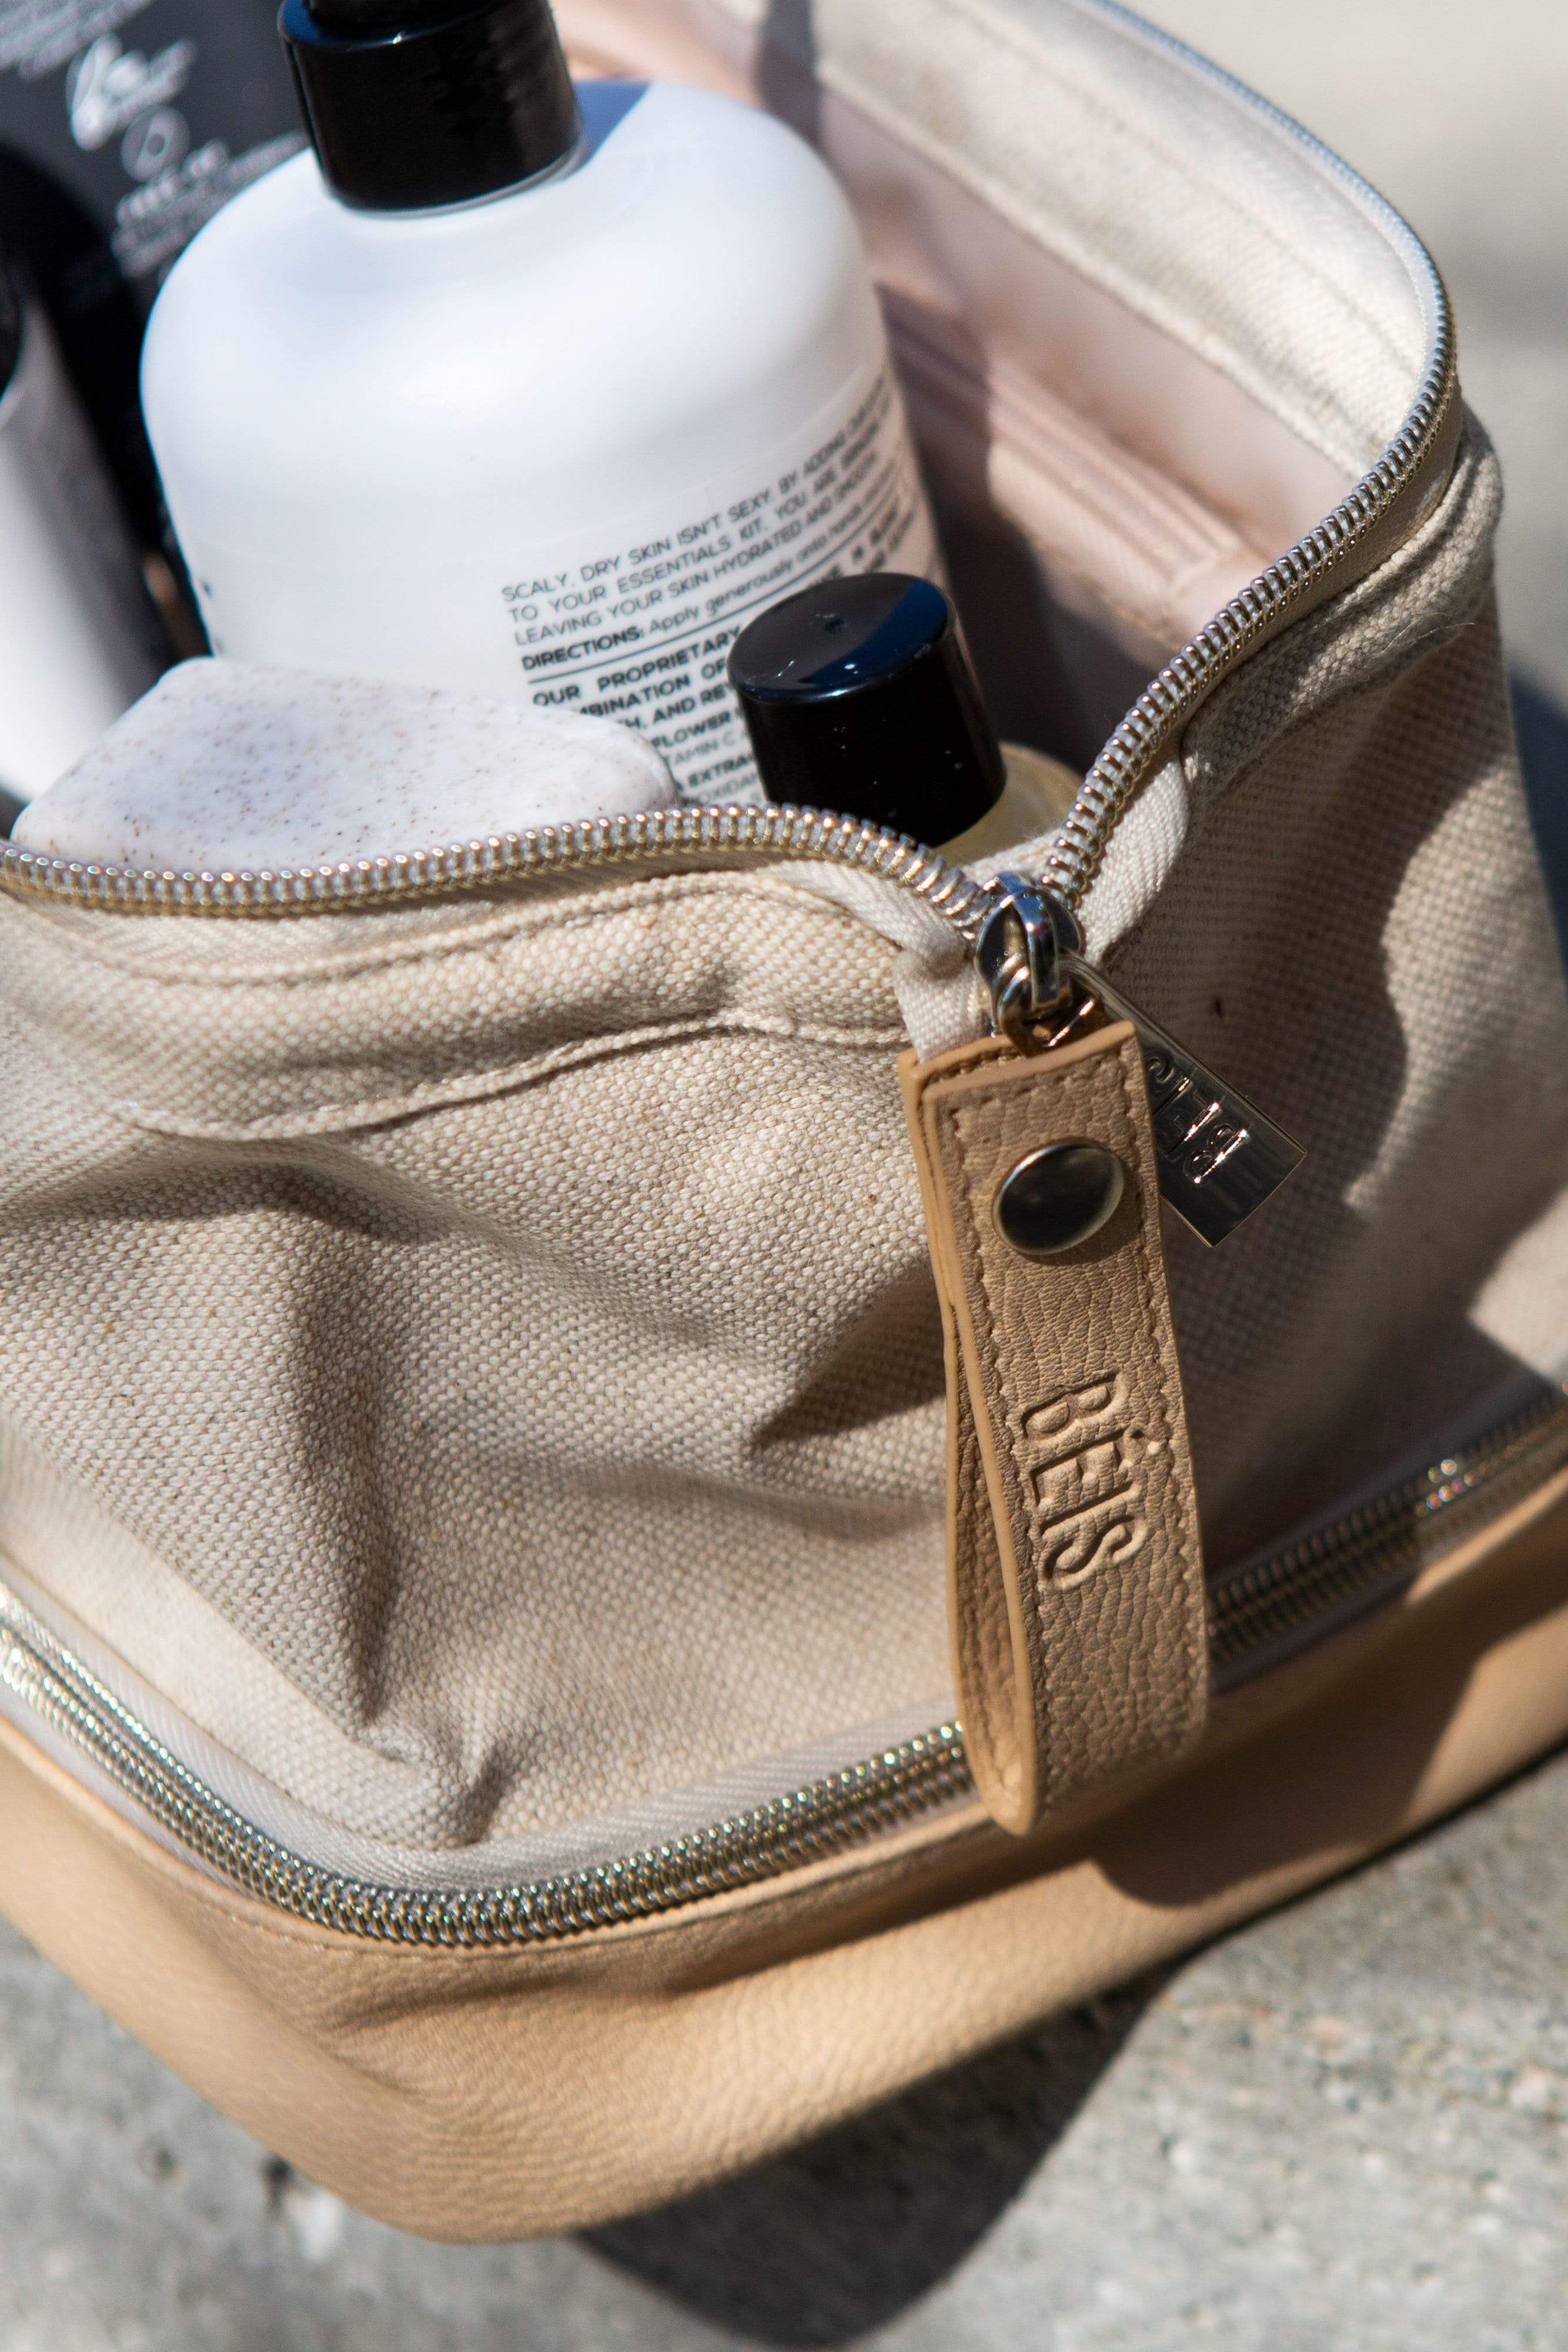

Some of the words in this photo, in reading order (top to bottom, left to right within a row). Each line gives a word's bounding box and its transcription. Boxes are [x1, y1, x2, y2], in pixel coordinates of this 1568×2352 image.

[509, 604, 538, 622] TO
[549, 585, 606, 613] YOUR
[617, 534, 731, 593] ESSENTIALS
[774, 489, 807, 519] YOU
[580, 556, 620, 581] DRY
[628, 537, 671, 564] SKIN
[677, 513, 720, 546] ISN'T
[779, 470, 797, 494] BY
[514, 611, 602, 646] LEAVING
[607, 589, 663, 619] YOUR
[668, 572, 709, 598] SKIN
[713, 520, 803, 577] HYDRATED
[521, 625, 644, 670] DIRECTIONS:
[650, 605, 699, 634] Apply
[706, 559, 793, 616] generously
[533, 684, 581, 706] OUR
[597, 625, 741, 692] PROPRIETARY
[653, 696, 696, 724] AND
